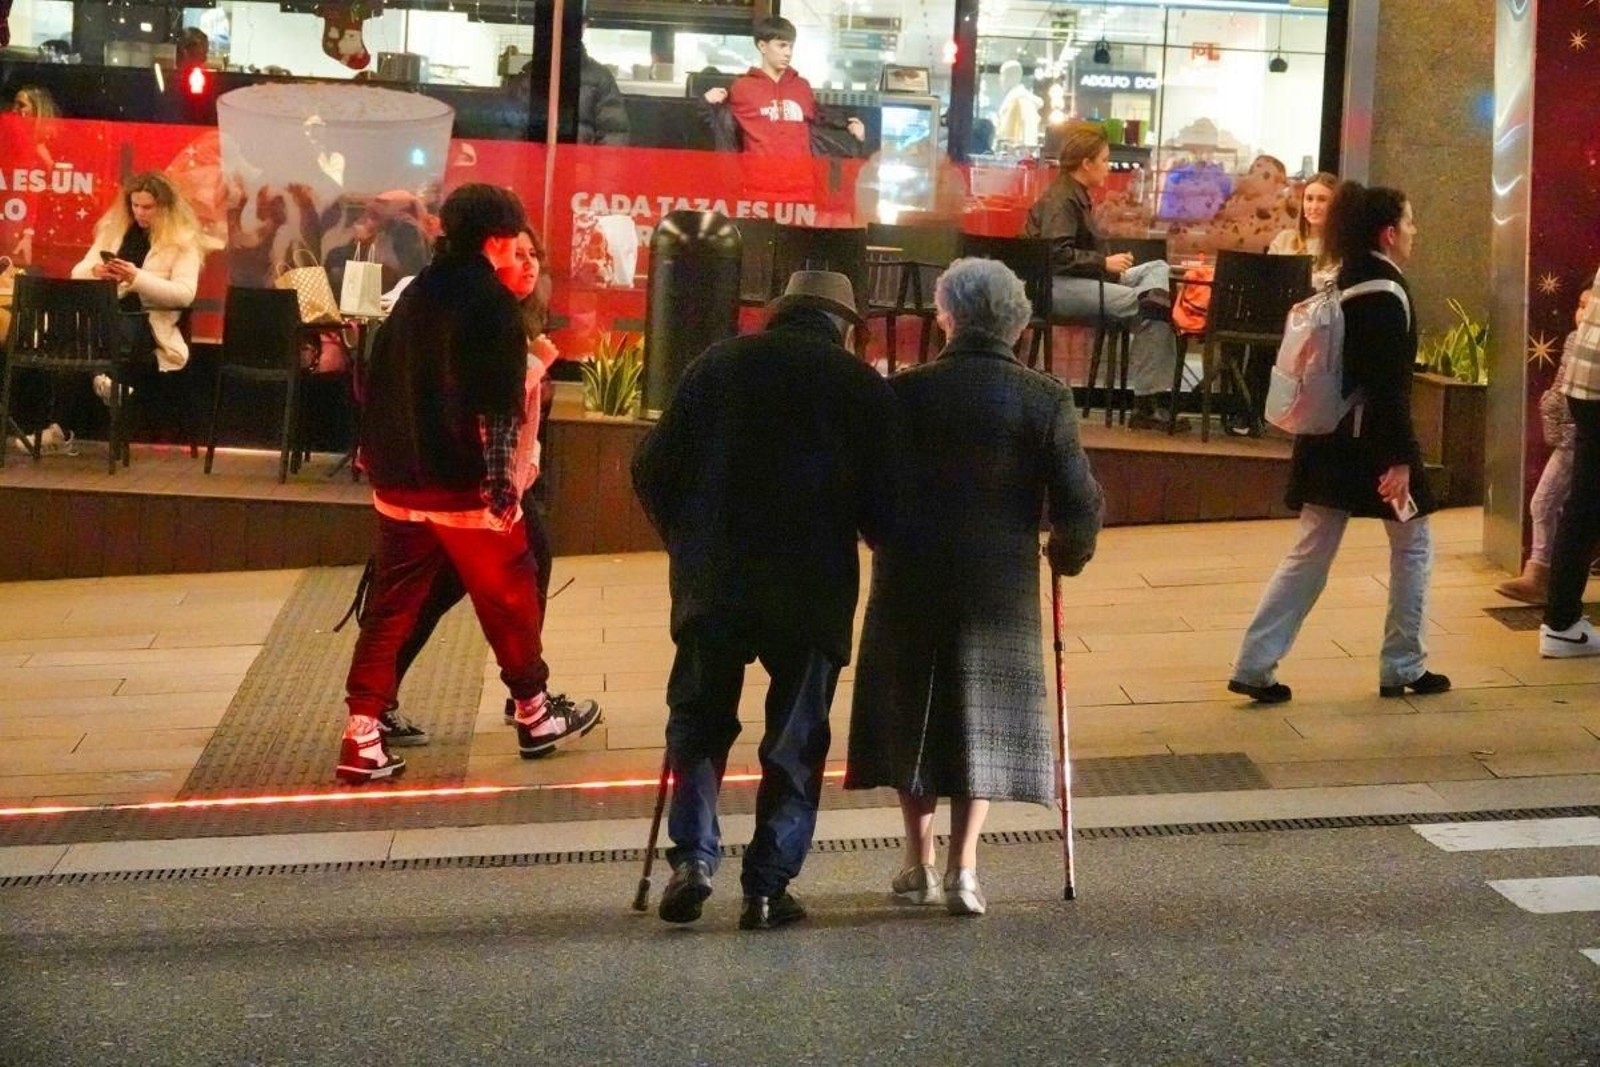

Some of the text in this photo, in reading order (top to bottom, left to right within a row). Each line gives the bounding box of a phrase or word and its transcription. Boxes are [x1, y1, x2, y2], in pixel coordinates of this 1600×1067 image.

[1080, 74, 1130, 88] ADOLFO
[13, 169, 46, 192] ES
[570, 191, 651, 218] CADA
[774, 202, 816, 226] UN
